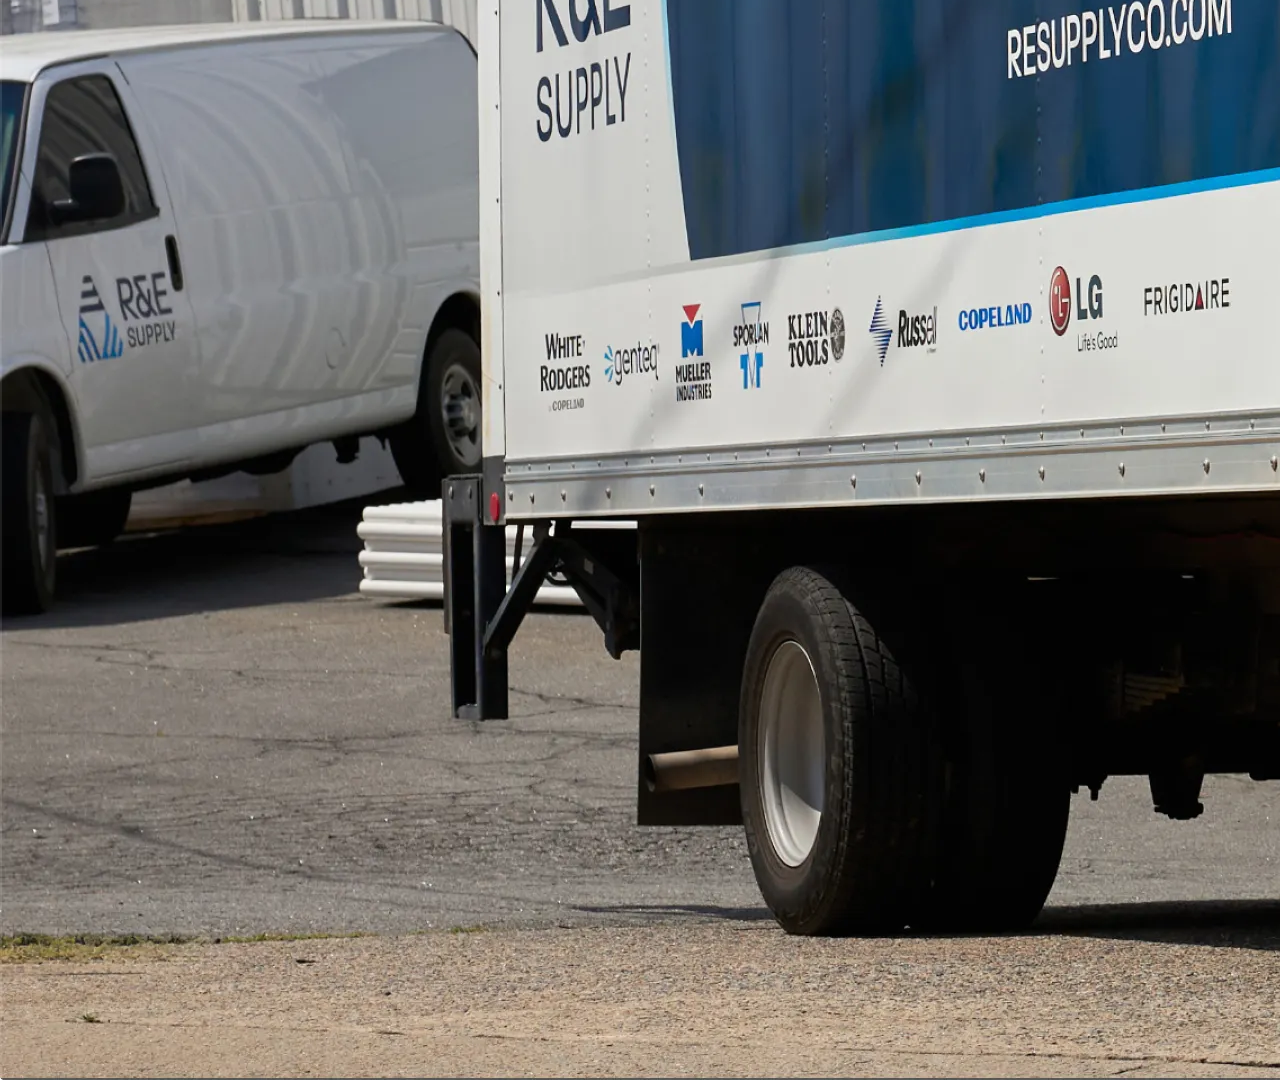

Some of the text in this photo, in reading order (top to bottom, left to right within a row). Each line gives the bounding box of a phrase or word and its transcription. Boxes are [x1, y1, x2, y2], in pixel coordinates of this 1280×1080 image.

[536, 52, 632, 143] SUPPLY
[116, 271, 173, 321] R&E
[1076, 274, 1104, 321] LG
[1144, 278, 1230, 316] FRIGIDAIRE
[788, 311, 828, 340] KLEIN
[897, 305, 938, 348] Russell
[958, 302, 1032, 332] COPELAND
[127, 321, 176, 348] SUPPLY
[733, 322, 769, 347] SPORLAN
[1097, 330, 1118, 350] Good
[614, 340, 659, 386] genteq
[788, 339, 829, 368] TOOLS
[675, 362, 712, 383] MUELLER
[676, 383, 712, 402] INDUSTRIES
